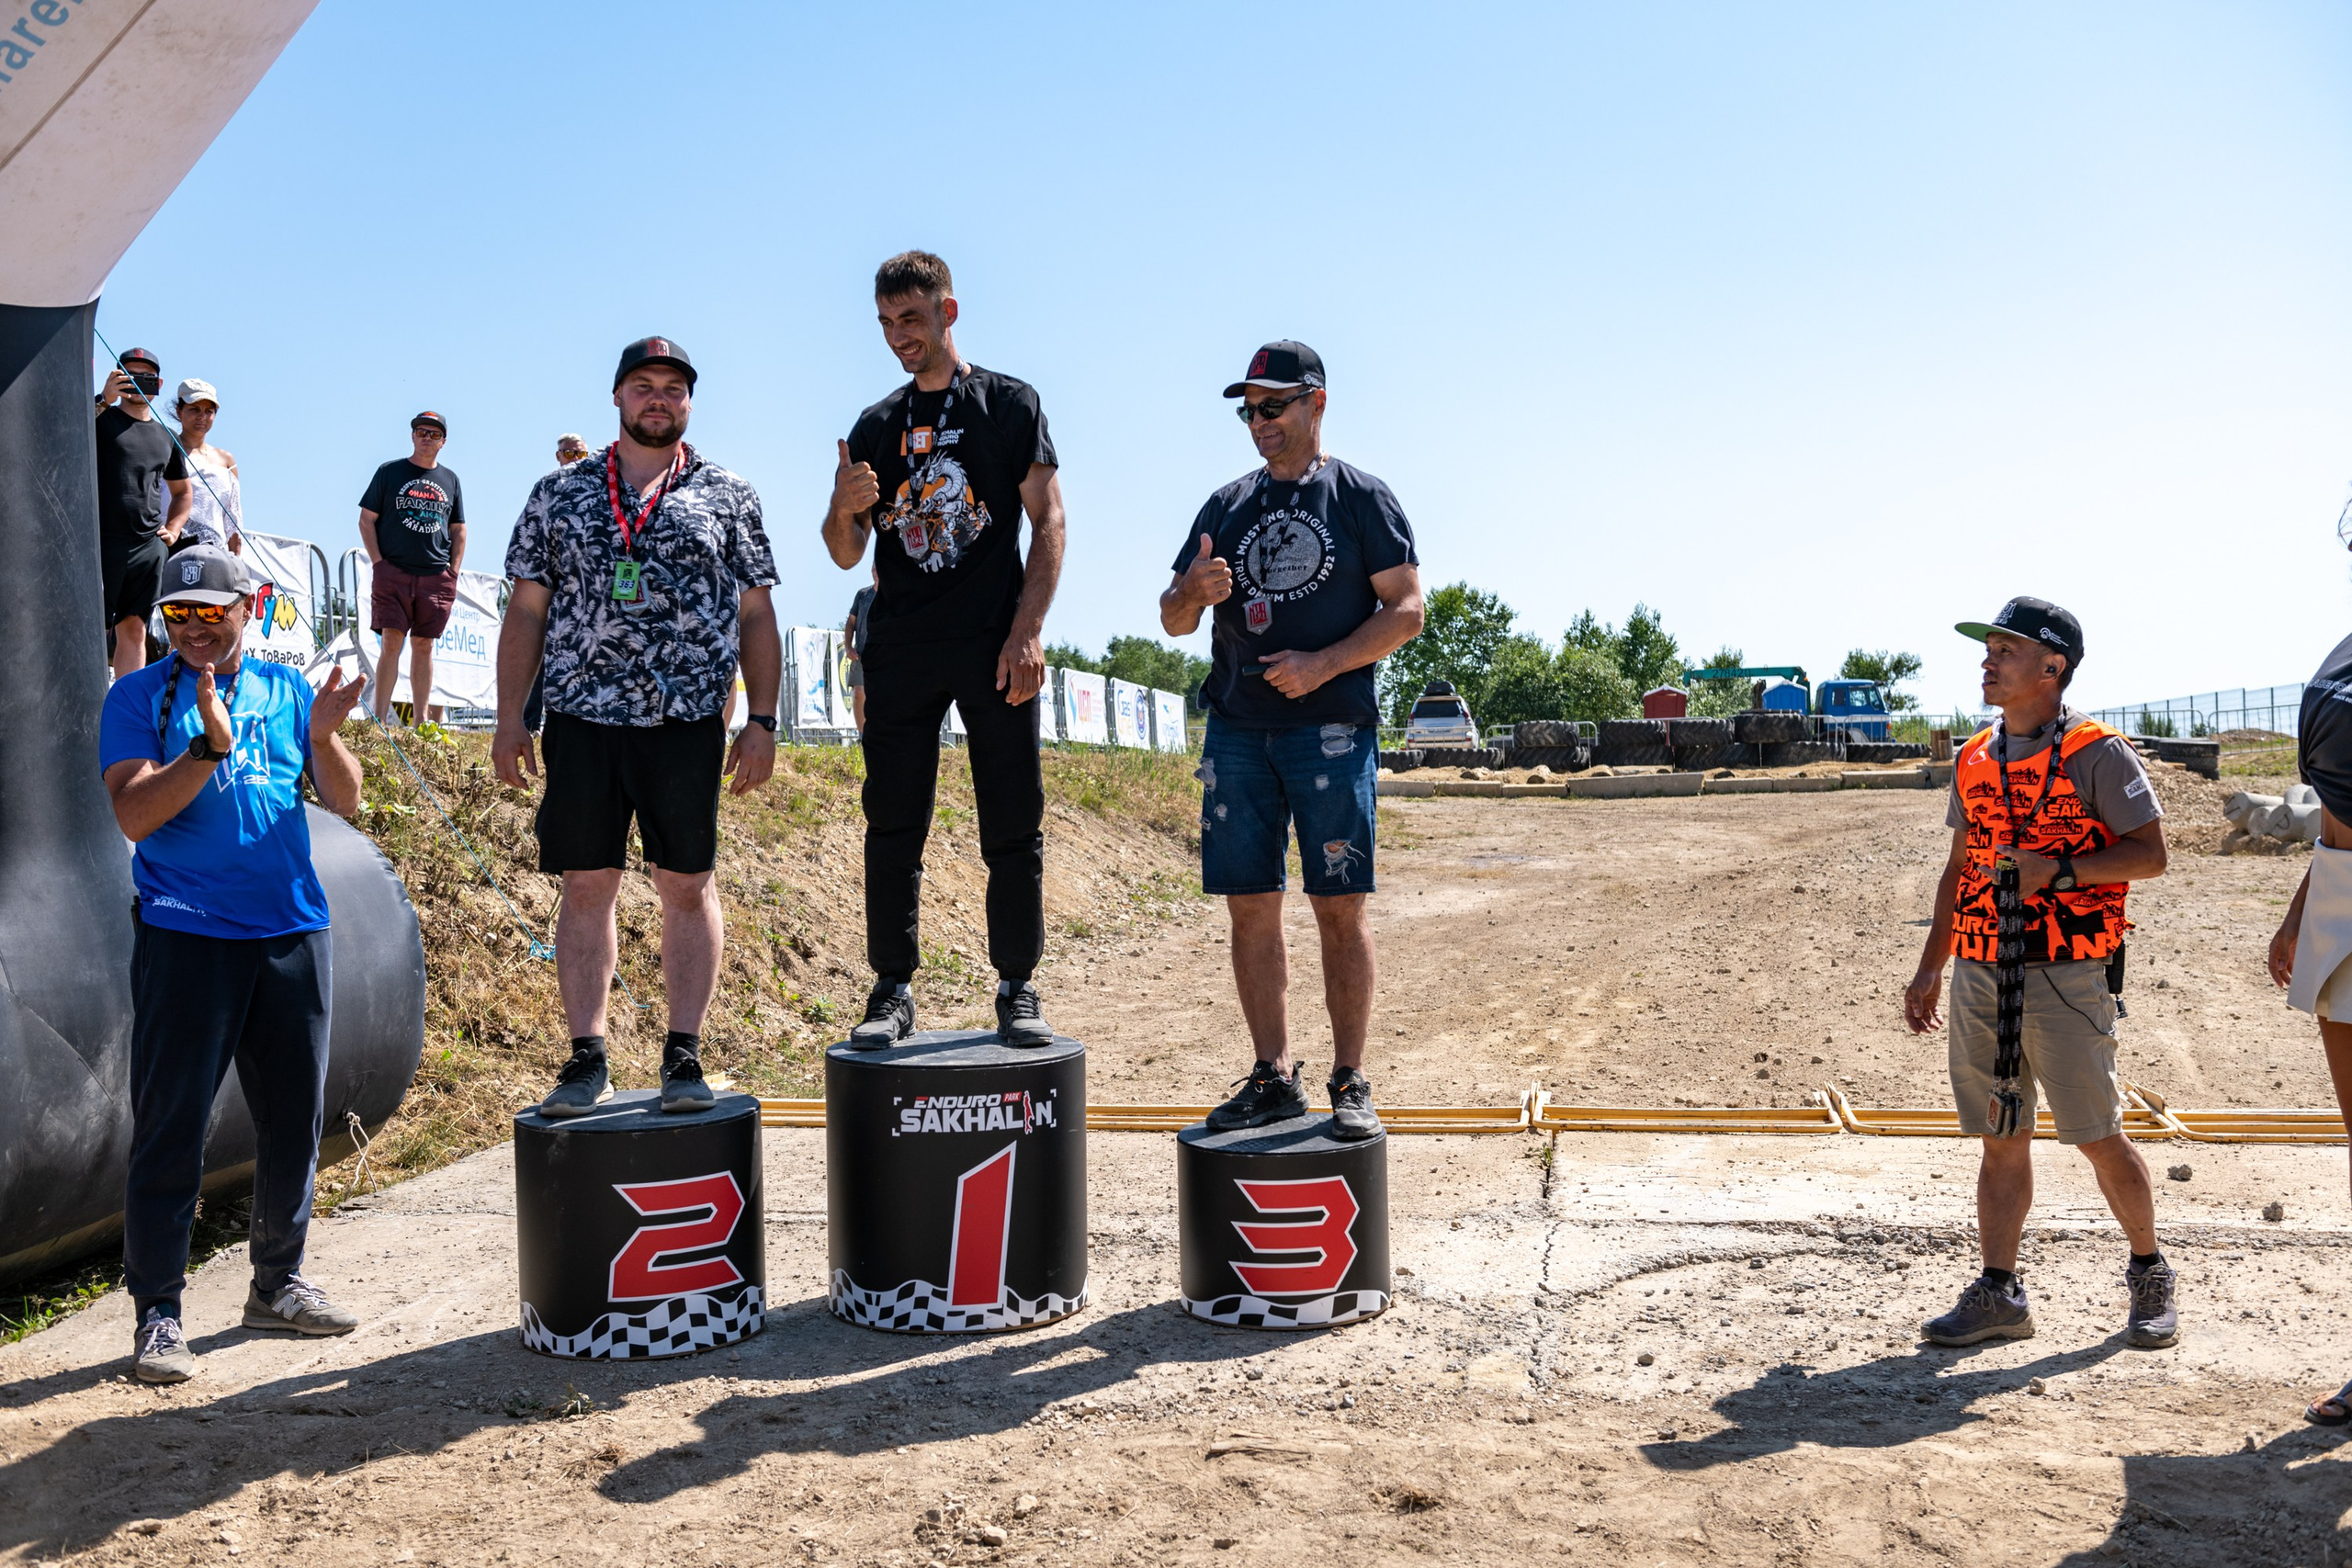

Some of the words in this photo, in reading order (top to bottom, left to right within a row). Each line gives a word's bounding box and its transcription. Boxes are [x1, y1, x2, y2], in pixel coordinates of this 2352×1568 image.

[0, 0, 85, 85] are
[395, 496, 451, 516] FAMILY
[1236, 509, 1285, 556] MUSTNG
[1234, 558, 1250, 589] TRUE
[1288, 581, 1318, 601] ESTD
[1317, 555, 1336, 581] 1932
[435, 625, 486, 660] реМед
[2047, 804, 2086, 818] SAK
[899, 1090, 1053, 1135] SAKHALIN
[914, 1093, 1001, 1110] ENDURO
[1005, 1092, 1021, 1102] PARK
[607, 1170, 746, 1303] 2
[946, 1140, 1017, 1310] 1
[1227, 1175, 1361, 1296] 3
